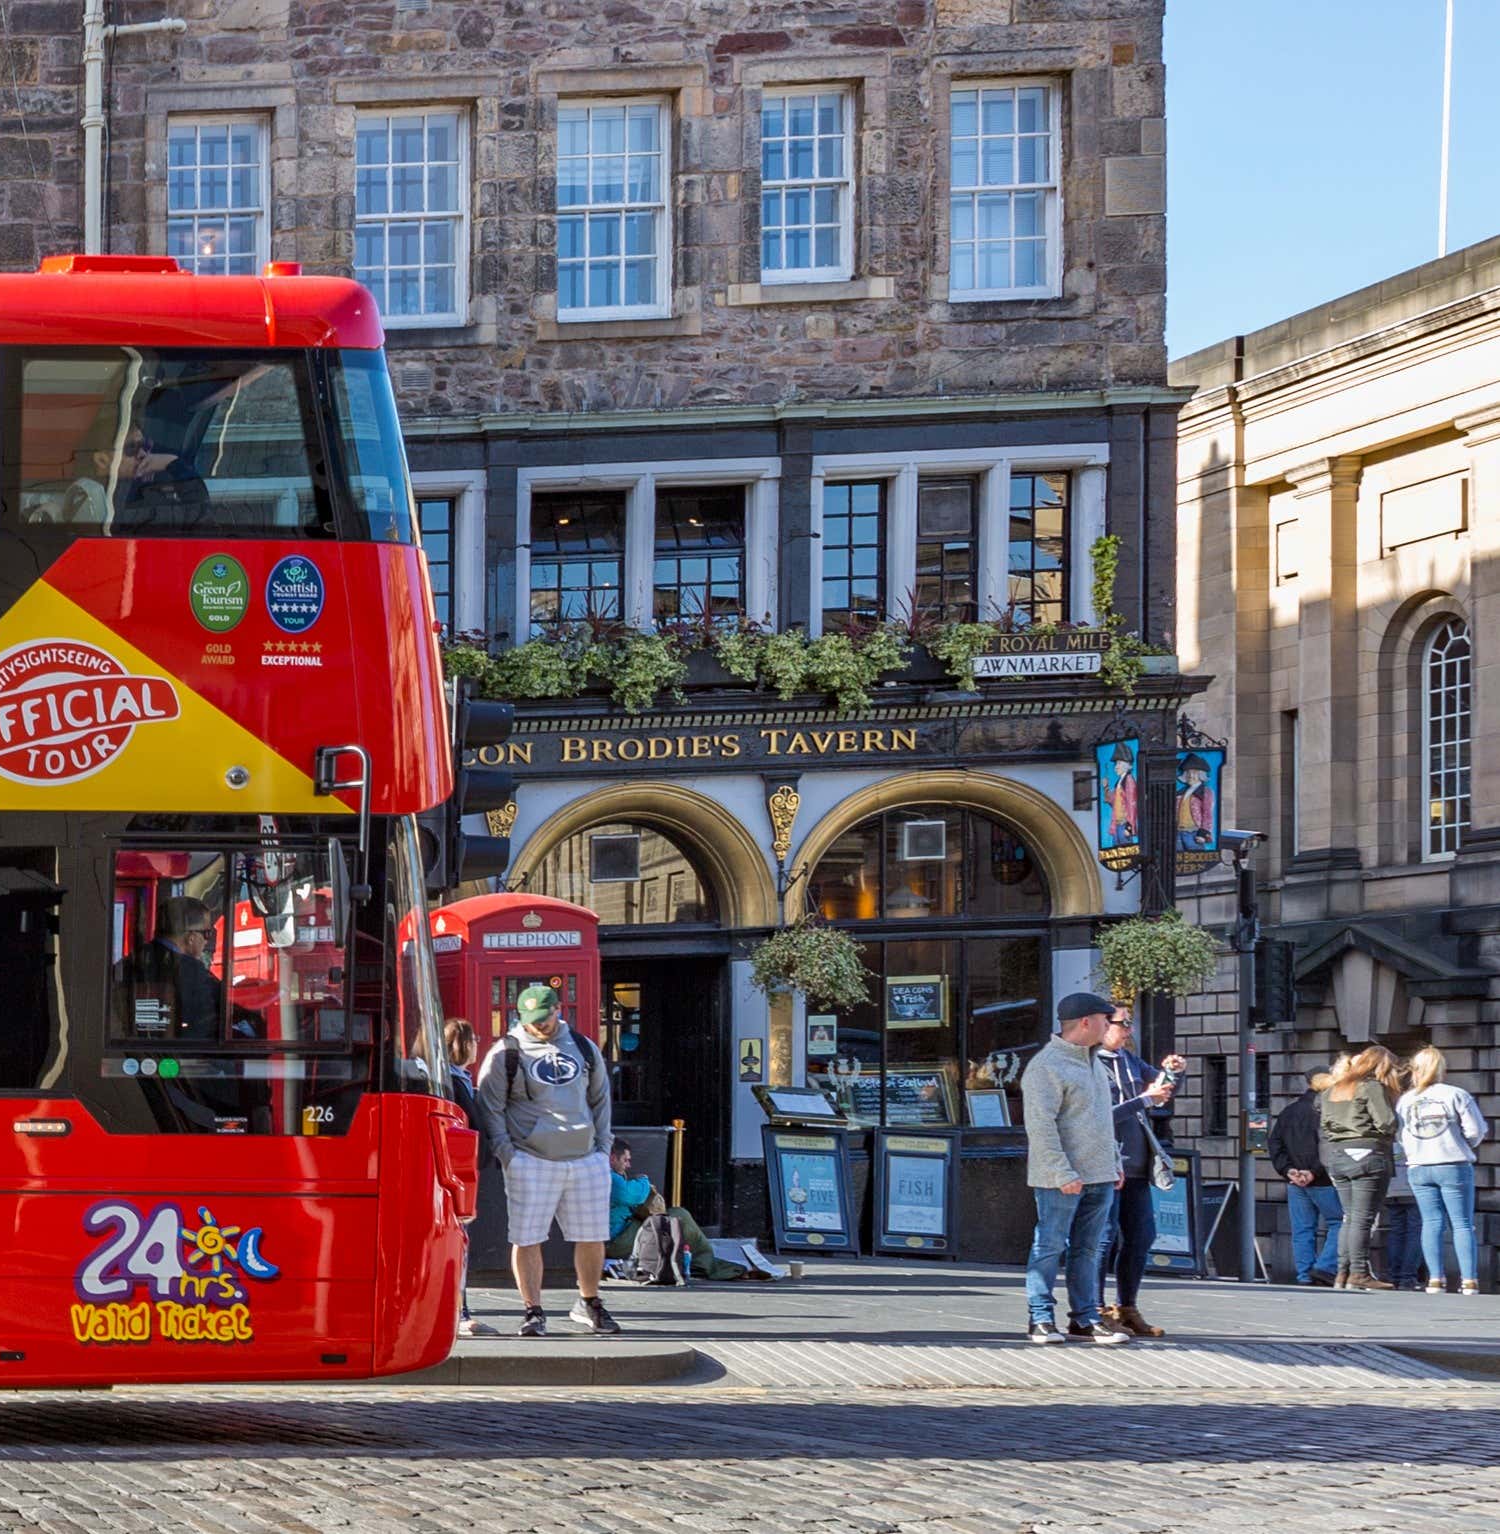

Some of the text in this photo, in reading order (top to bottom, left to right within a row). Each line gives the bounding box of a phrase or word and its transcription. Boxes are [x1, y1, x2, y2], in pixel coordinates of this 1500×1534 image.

[193, 583, 225, 596] Green
[273, 581, 318, 593] Scottish
[202, 595, 244, 605] Tourism
[206, 644, 232, 653] GOLD
[1000, 636, 1059, 653] ROYAL
[1065, 633, 1110, 651] MILE
[201, 655, 236, 665] AWARD
[261, 655, 323, 666] EXCEPTIONAL
[560, 733, 742, 763] BRODIE'S
[759, 727, 919, 757] TAVERN
[26, 733, 118, 774] TOUR
[487, 932, 577, 947] TELEPHONE
[306, 1105, 335, 1123] 226
[810, 1188, 835, 1203] FIVE
[898, 1179, 934, 1197] FISH
[1159, 1212, 1185, 1226] FIVE
[79, 1202, 186, 1297] 24
[70, 1300, 254, 1343] Valid Ticket
